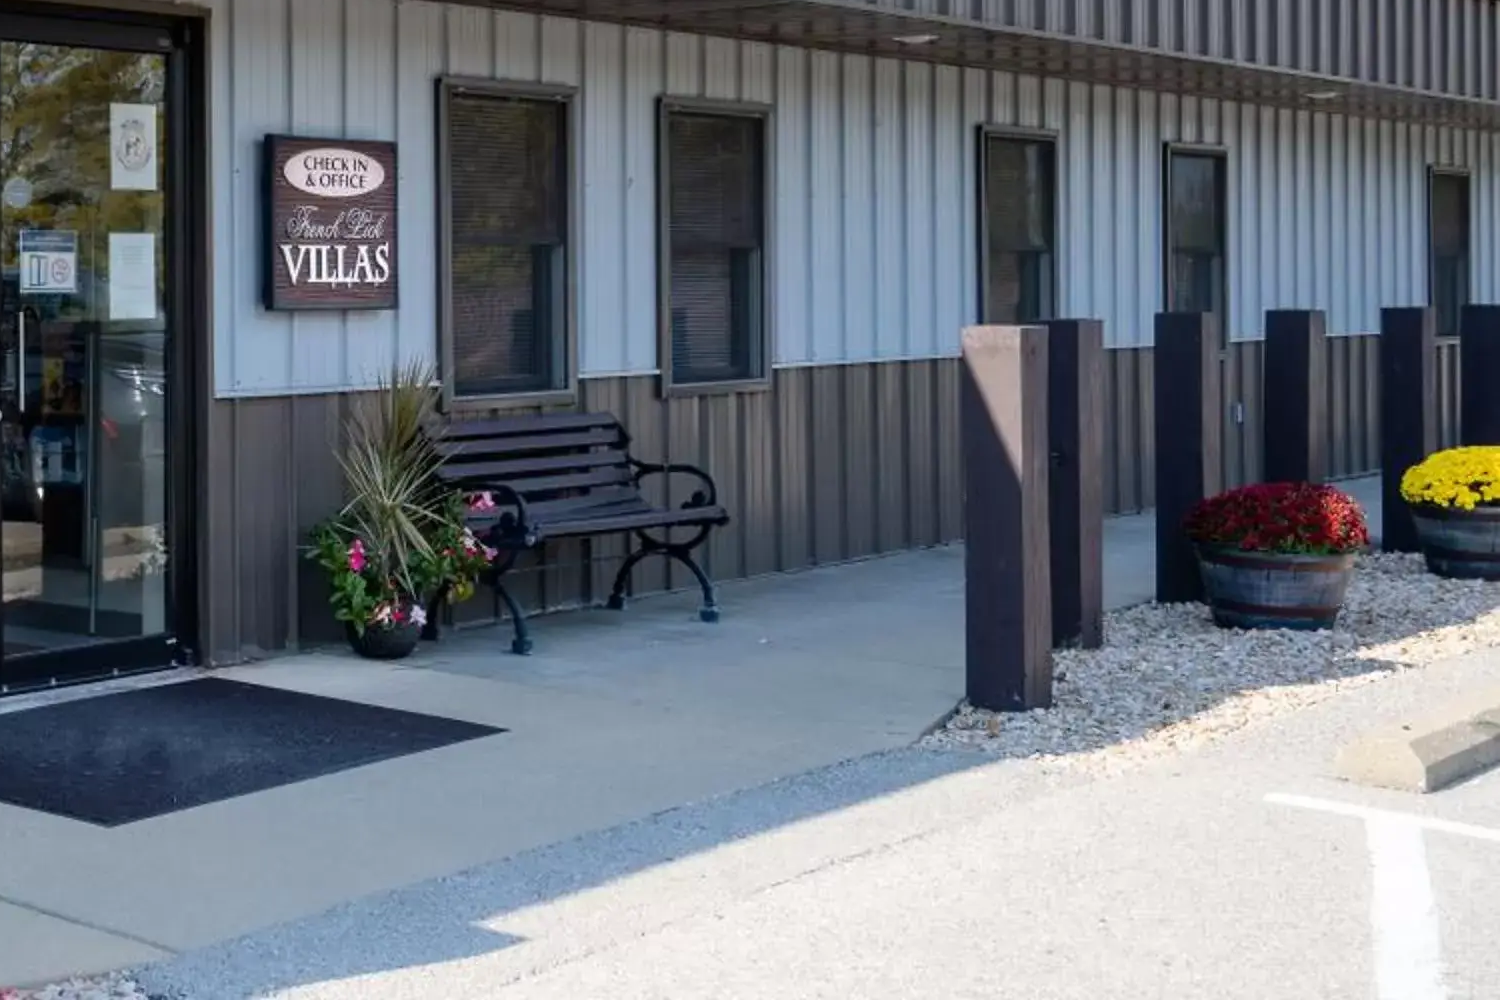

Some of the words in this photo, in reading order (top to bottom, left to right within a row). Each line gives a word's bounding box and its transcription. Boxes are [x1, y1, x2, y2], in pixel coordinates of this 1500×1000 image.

[303, 156, 349, 172] CHECK
[353, 158, 369, 173] IN
[305, 174, 316, 188] &
[319, 173, 368, 189] OFFICE
[286, 205, 345, 239] French
[279, 242, 389, 288] VILLAS
